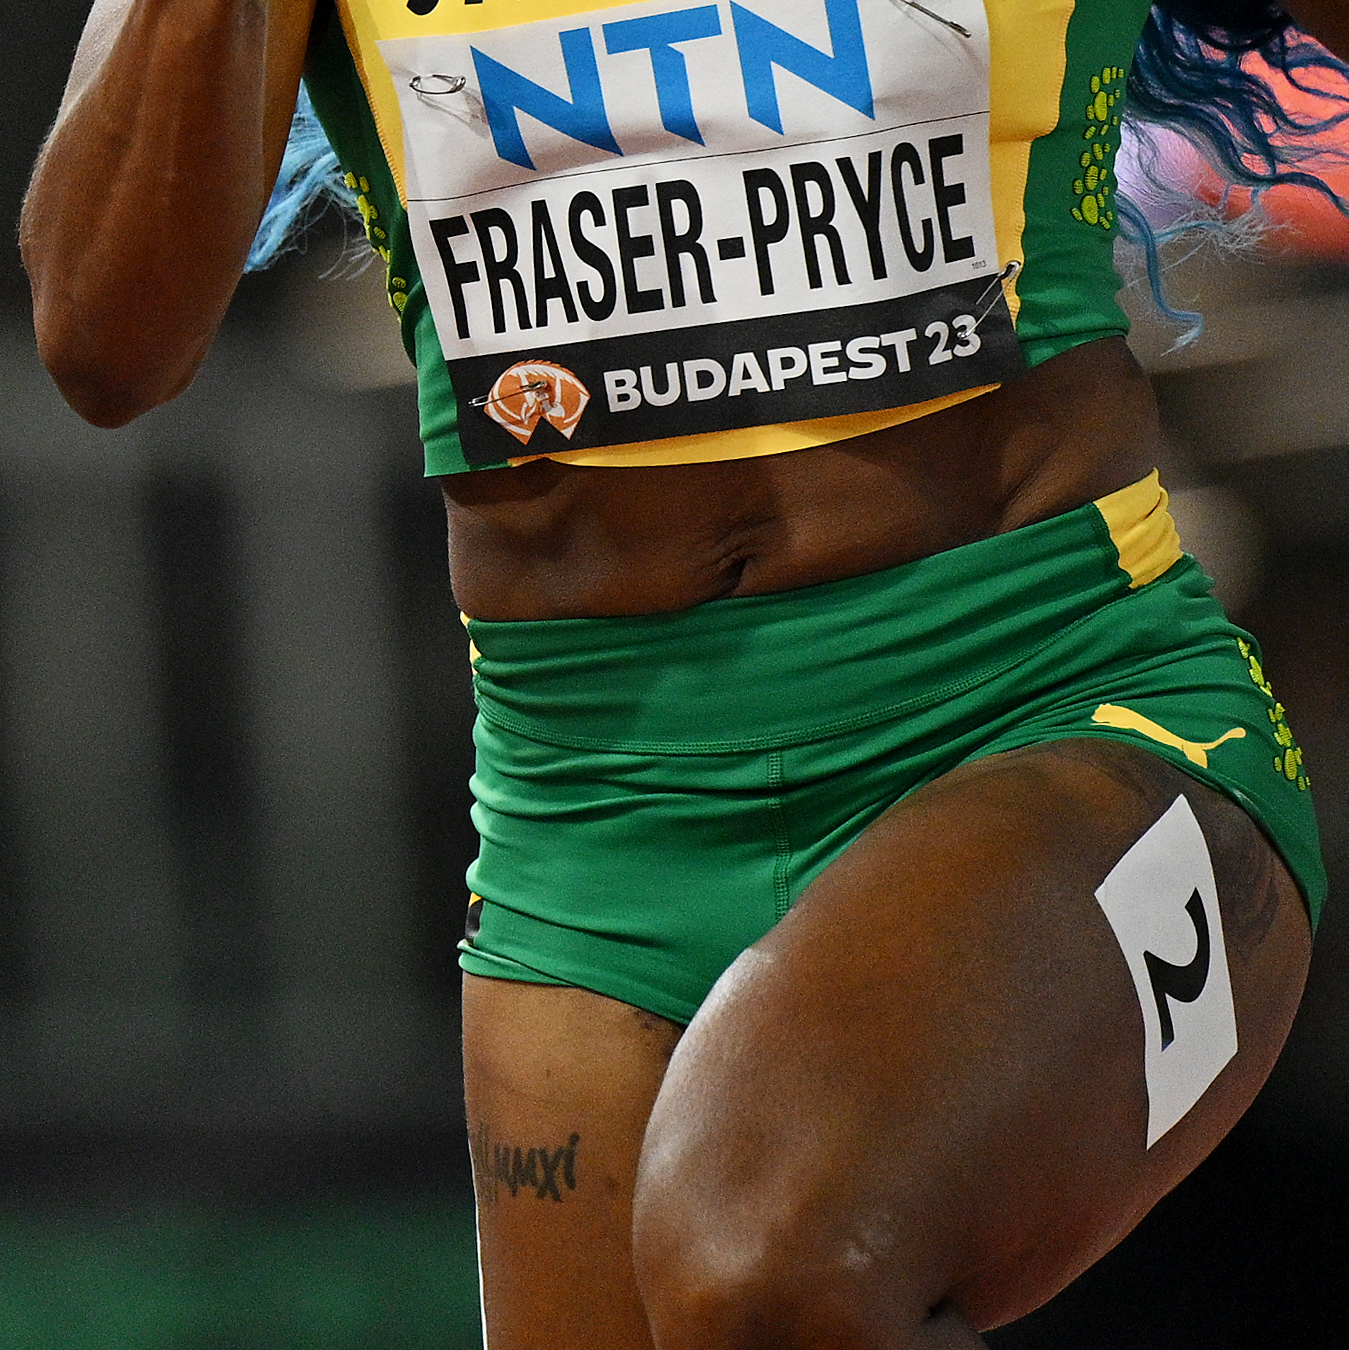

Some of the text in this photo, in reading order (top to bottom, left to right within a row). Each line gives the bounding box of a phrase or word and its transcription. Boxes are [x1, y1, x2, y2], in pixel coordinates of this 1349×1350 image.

[429, 134, 976, 340] FRASER-PRYCE
[604, 314, 981, 412] BUDAPEST 23
[1143, 887, 1210, 1051] 2
